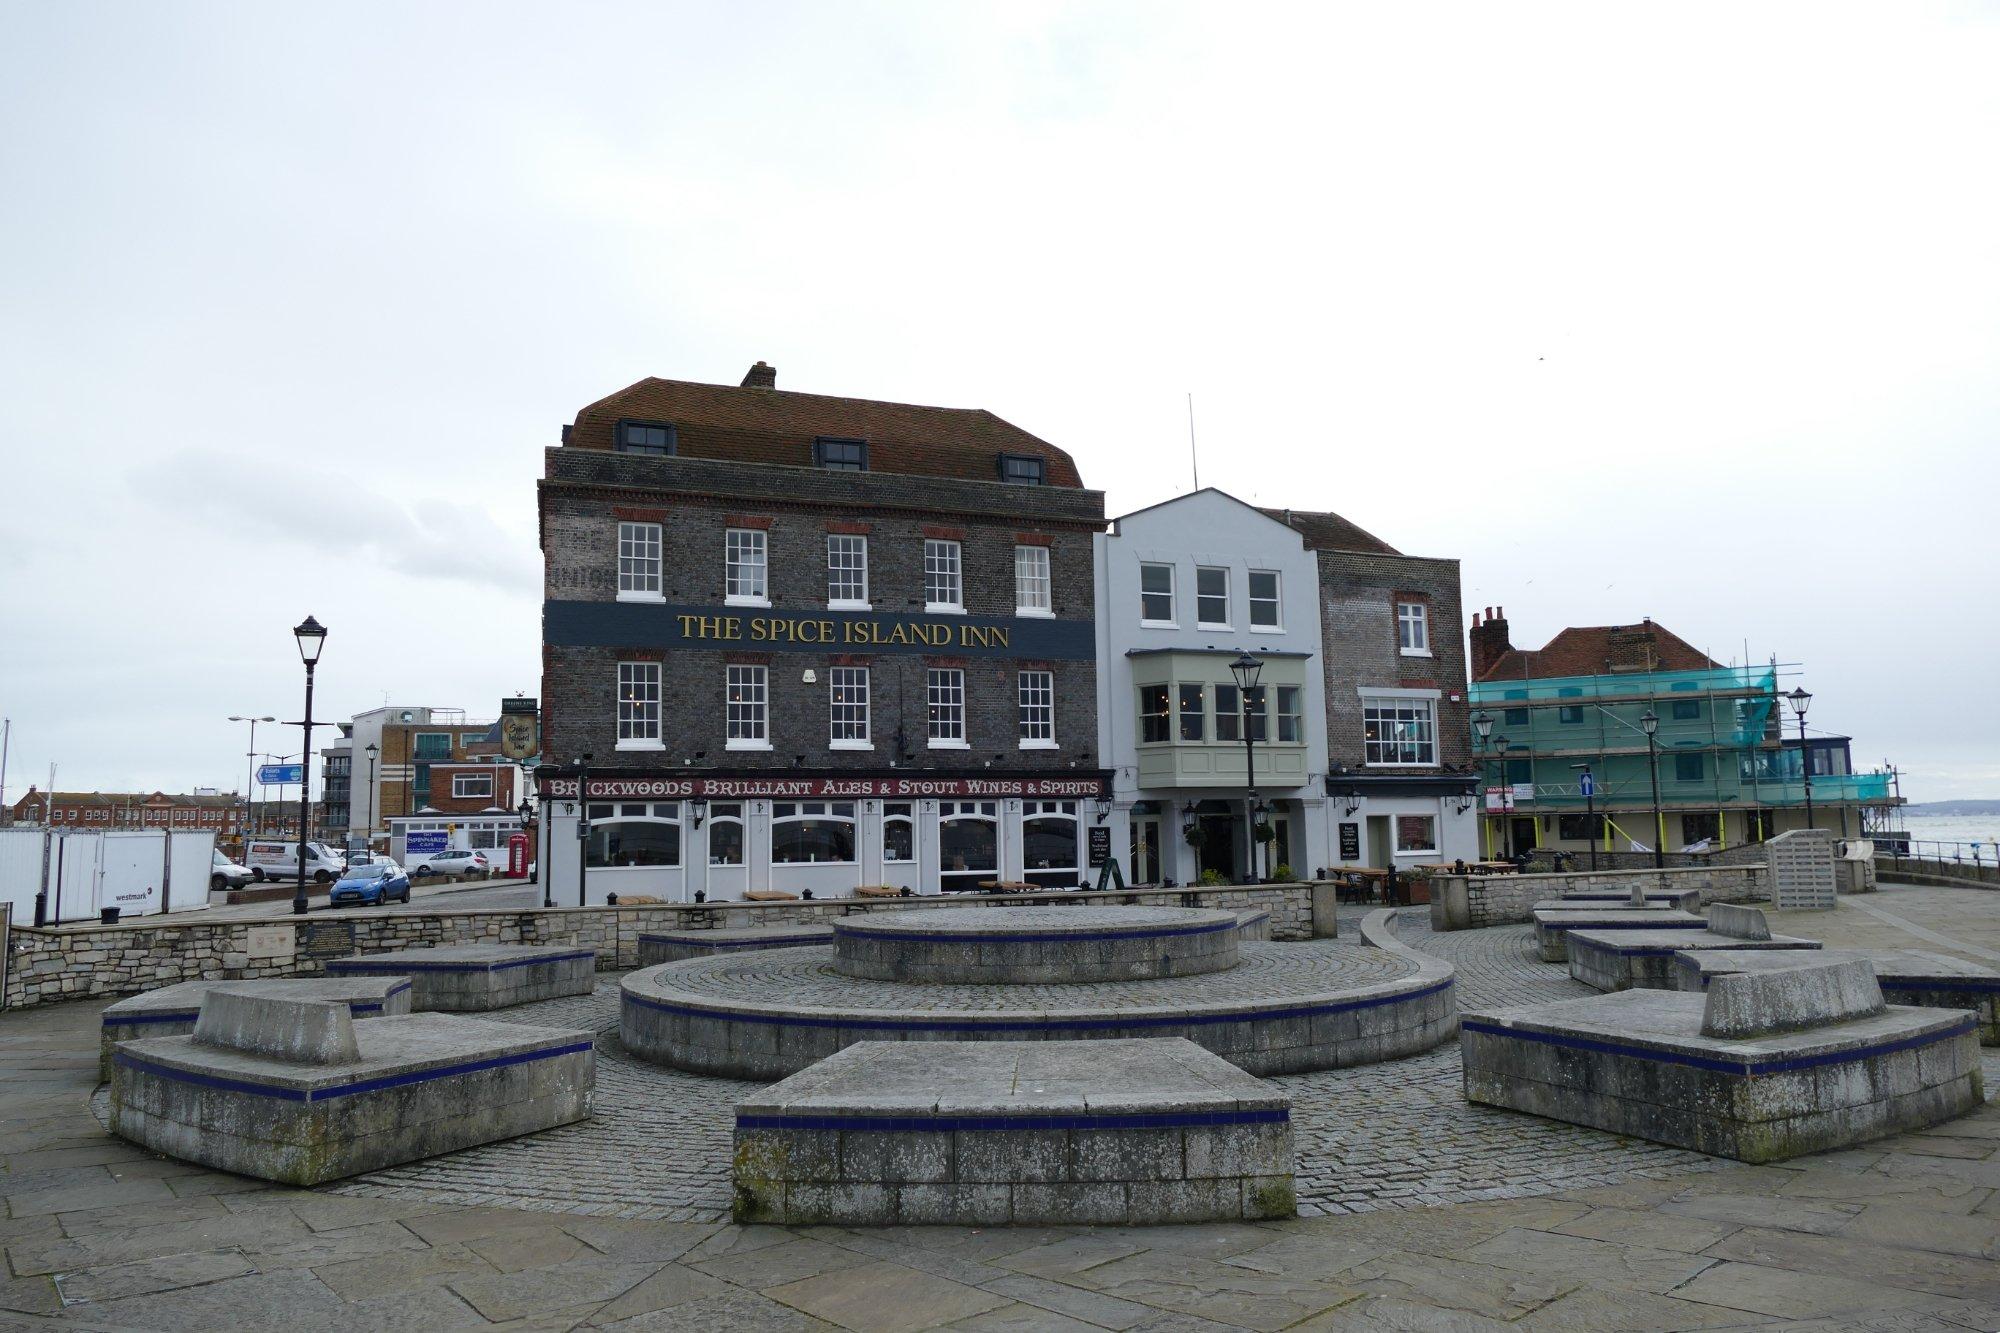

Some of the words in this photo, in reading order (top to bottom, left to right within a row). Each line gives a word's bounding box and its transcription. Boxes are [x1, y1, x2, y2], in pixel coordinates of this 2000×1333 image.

[677, 614, 742, 640] THE
[751, 618, 836, 643] SPICE
[843, 621, 952, 647] ISLAND
[959, 625, 1010, 648] INN
[703, 779, 813, 796] BRILLIANT
[820, 779, 873, 795] ALES
[880, 782, 892, 794] &
[965, 779, 1022, 795] WINES
[1027, 782, 1037, 794] &
[1040, 780, 1099, 795] SPIRITS
[116, 892, 147, 901] westmark
